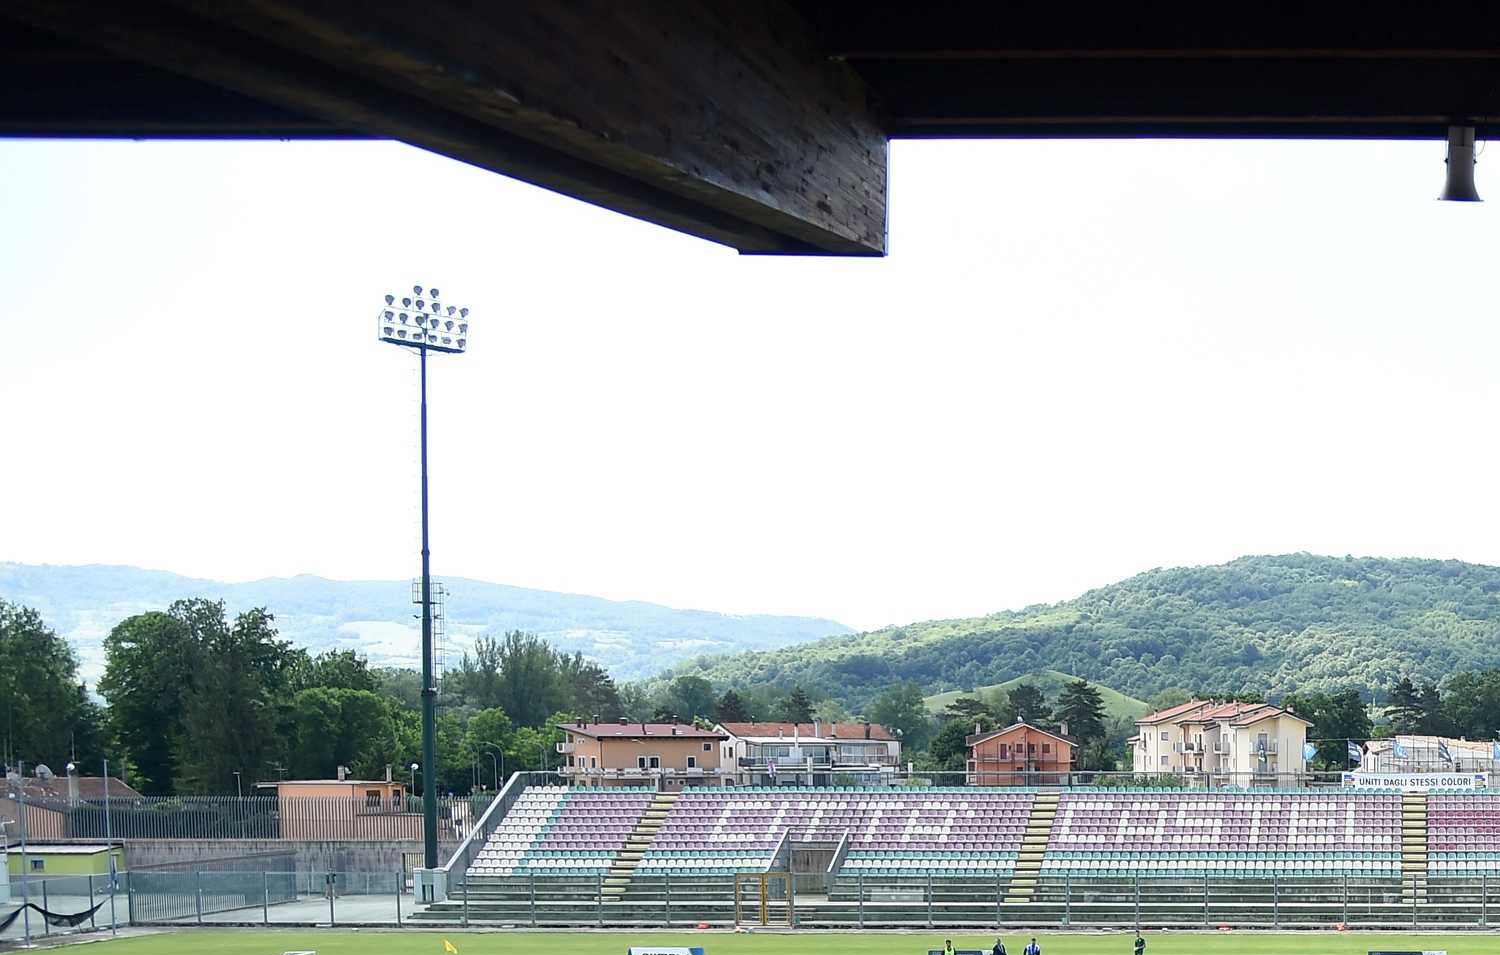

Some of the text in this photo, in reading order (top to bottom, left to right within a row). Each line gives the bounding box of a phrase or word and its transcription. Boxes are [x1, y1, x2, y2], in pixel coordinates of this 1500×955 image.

[1359, 777, 1471, 787] UNITI DAGLI STESSI COLORI
[1058, 801, 1393, 844] CASTEL
